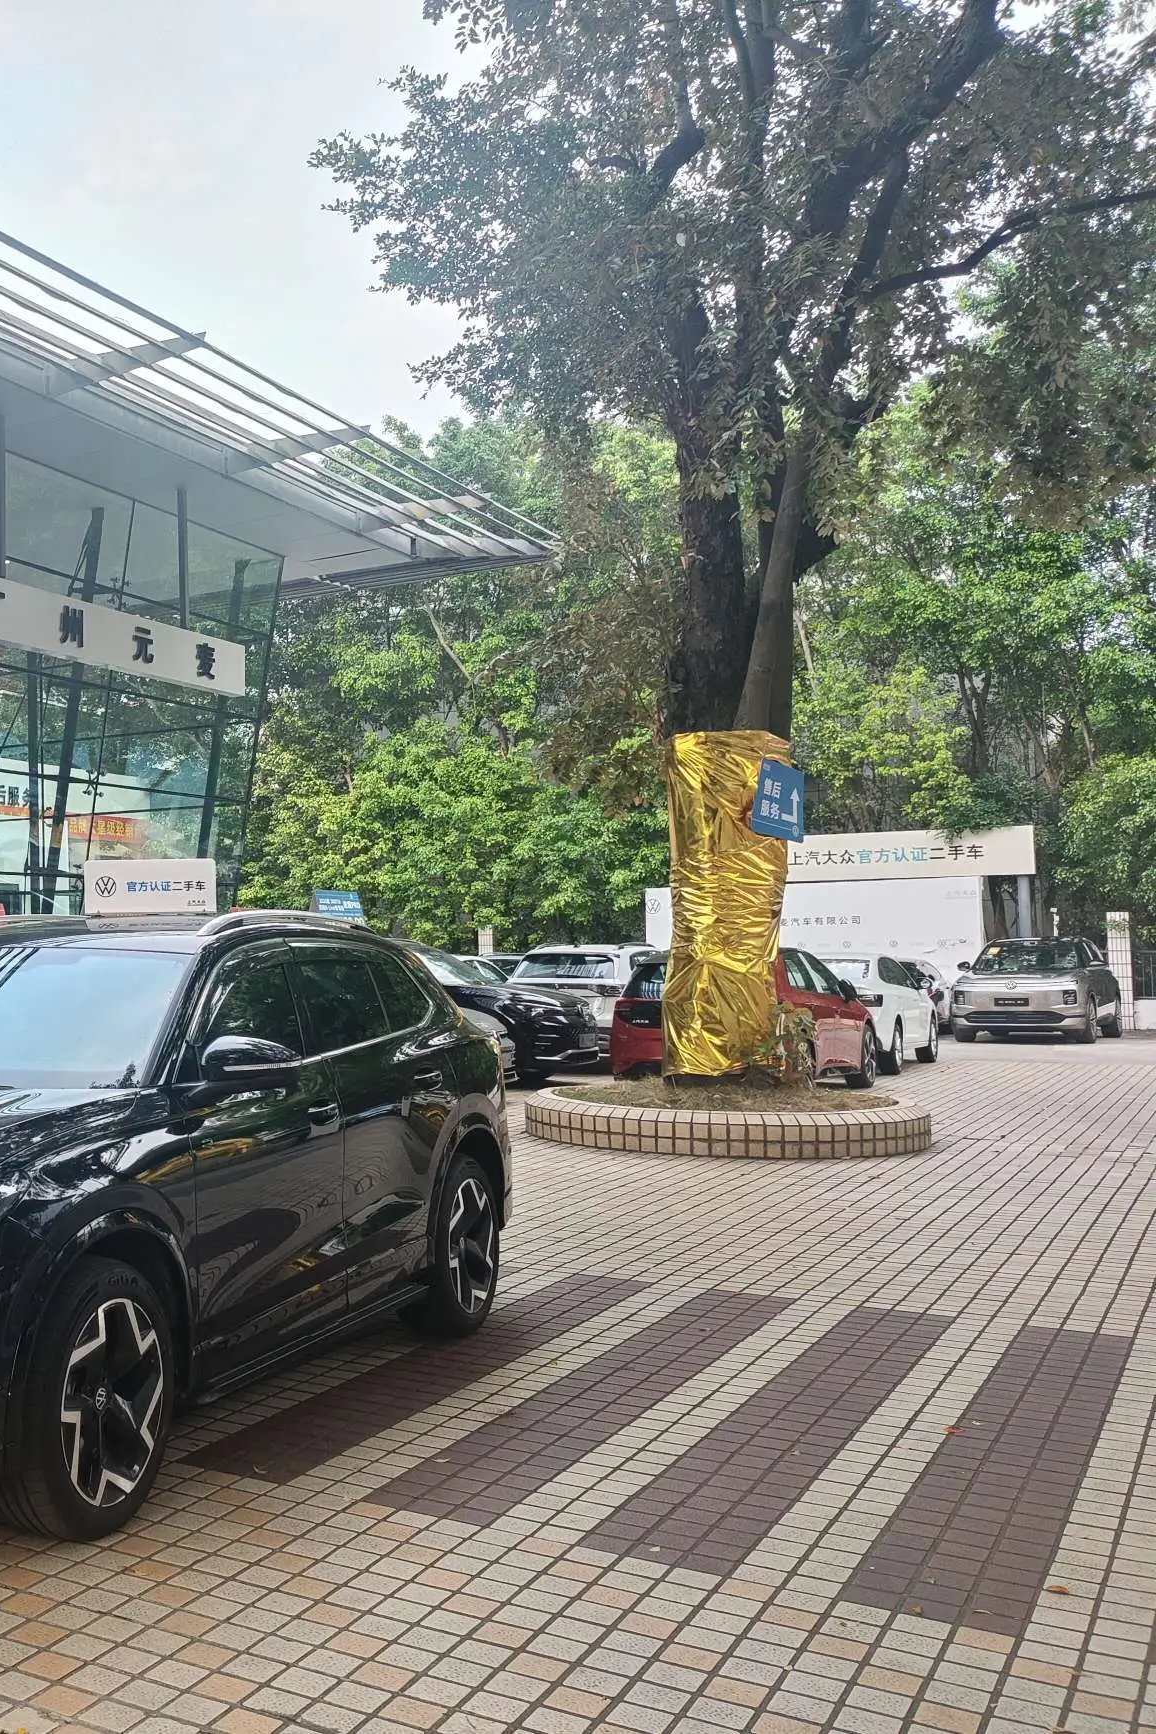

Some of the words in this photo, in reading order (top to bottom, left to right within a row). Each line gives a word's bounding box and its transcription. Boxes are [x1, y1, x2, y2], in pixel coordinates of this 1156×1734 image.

[763, 777, 782, 799] 售后
[760, 799, 780, 820] 服务
[788, 843, 984, 866] 上汽大众官方认证二手车
[126, 880, 207, 892] 官方认证二手车
